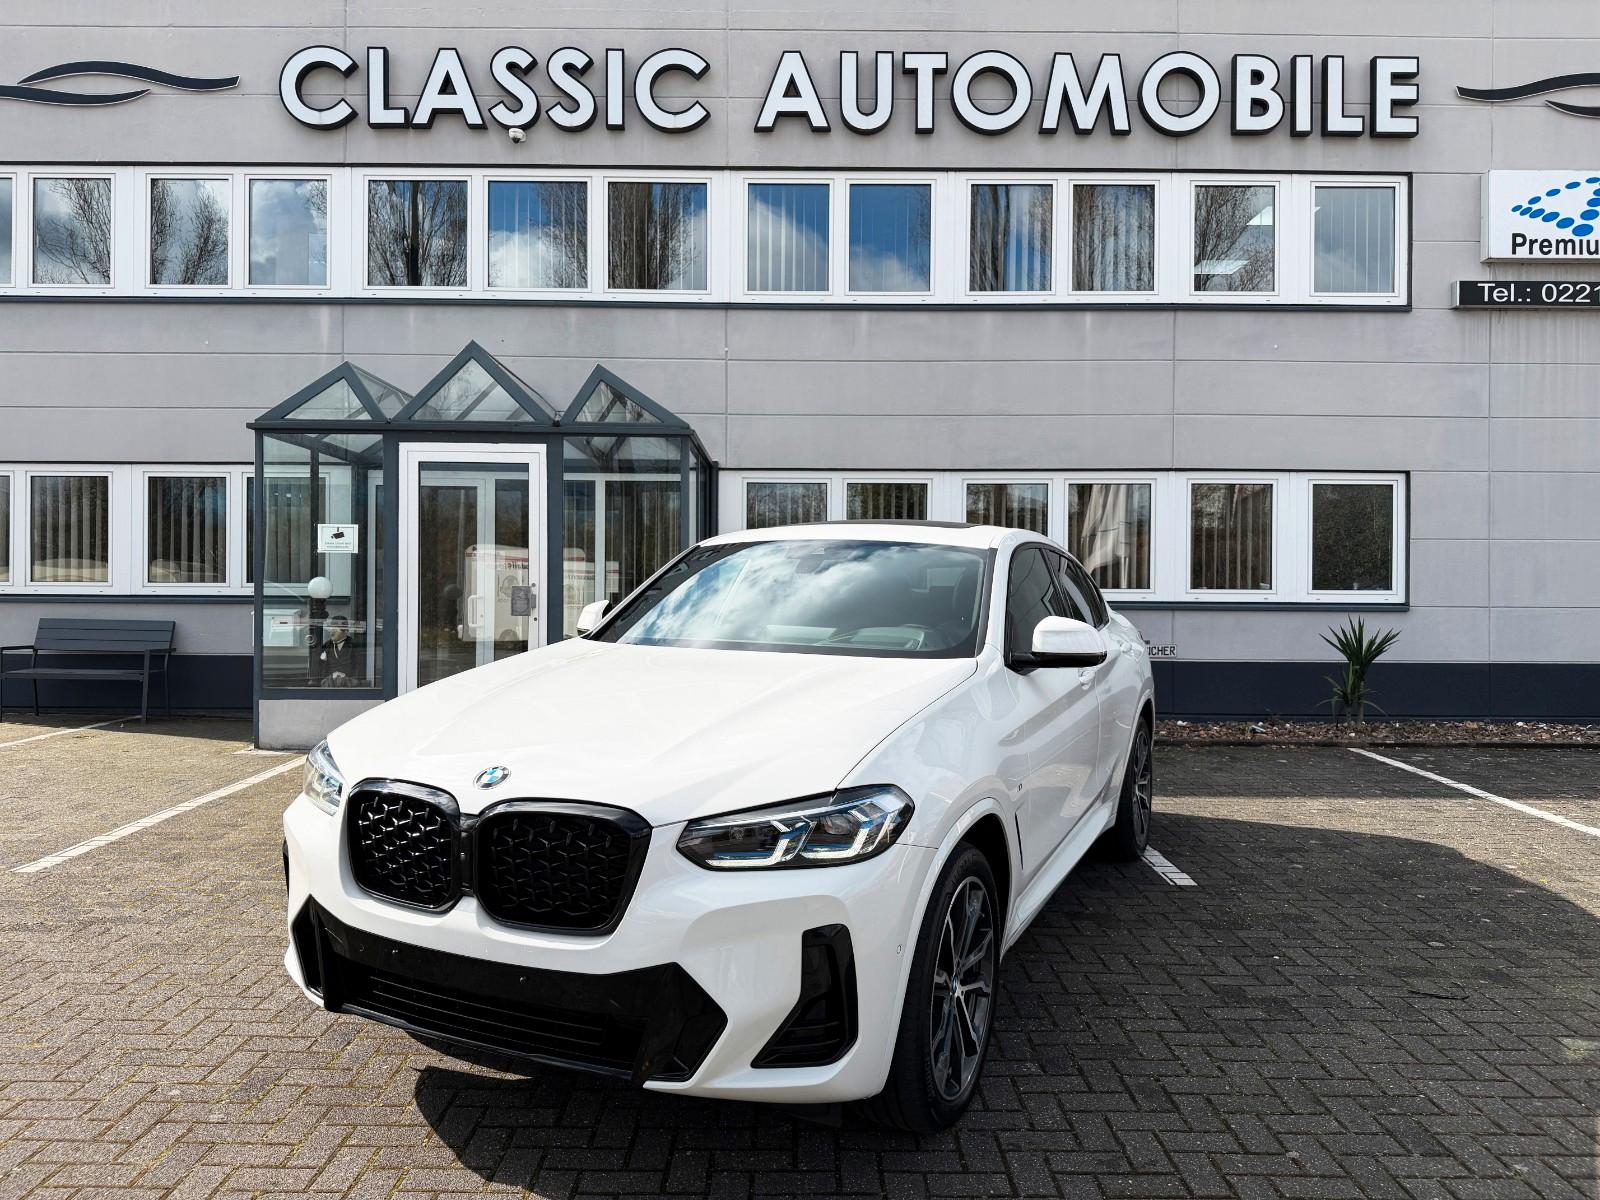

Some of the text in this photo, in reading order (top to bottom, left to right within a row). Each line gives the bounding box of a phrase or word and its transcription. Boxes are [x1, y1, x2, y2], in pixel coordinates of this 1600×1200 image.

[279, 45, 1420, 137] CLASSIC AUTOMOBILE
[1511, 233, 1600, 256] Premiu
[1477, 283, 1531, 302] Tel.:
